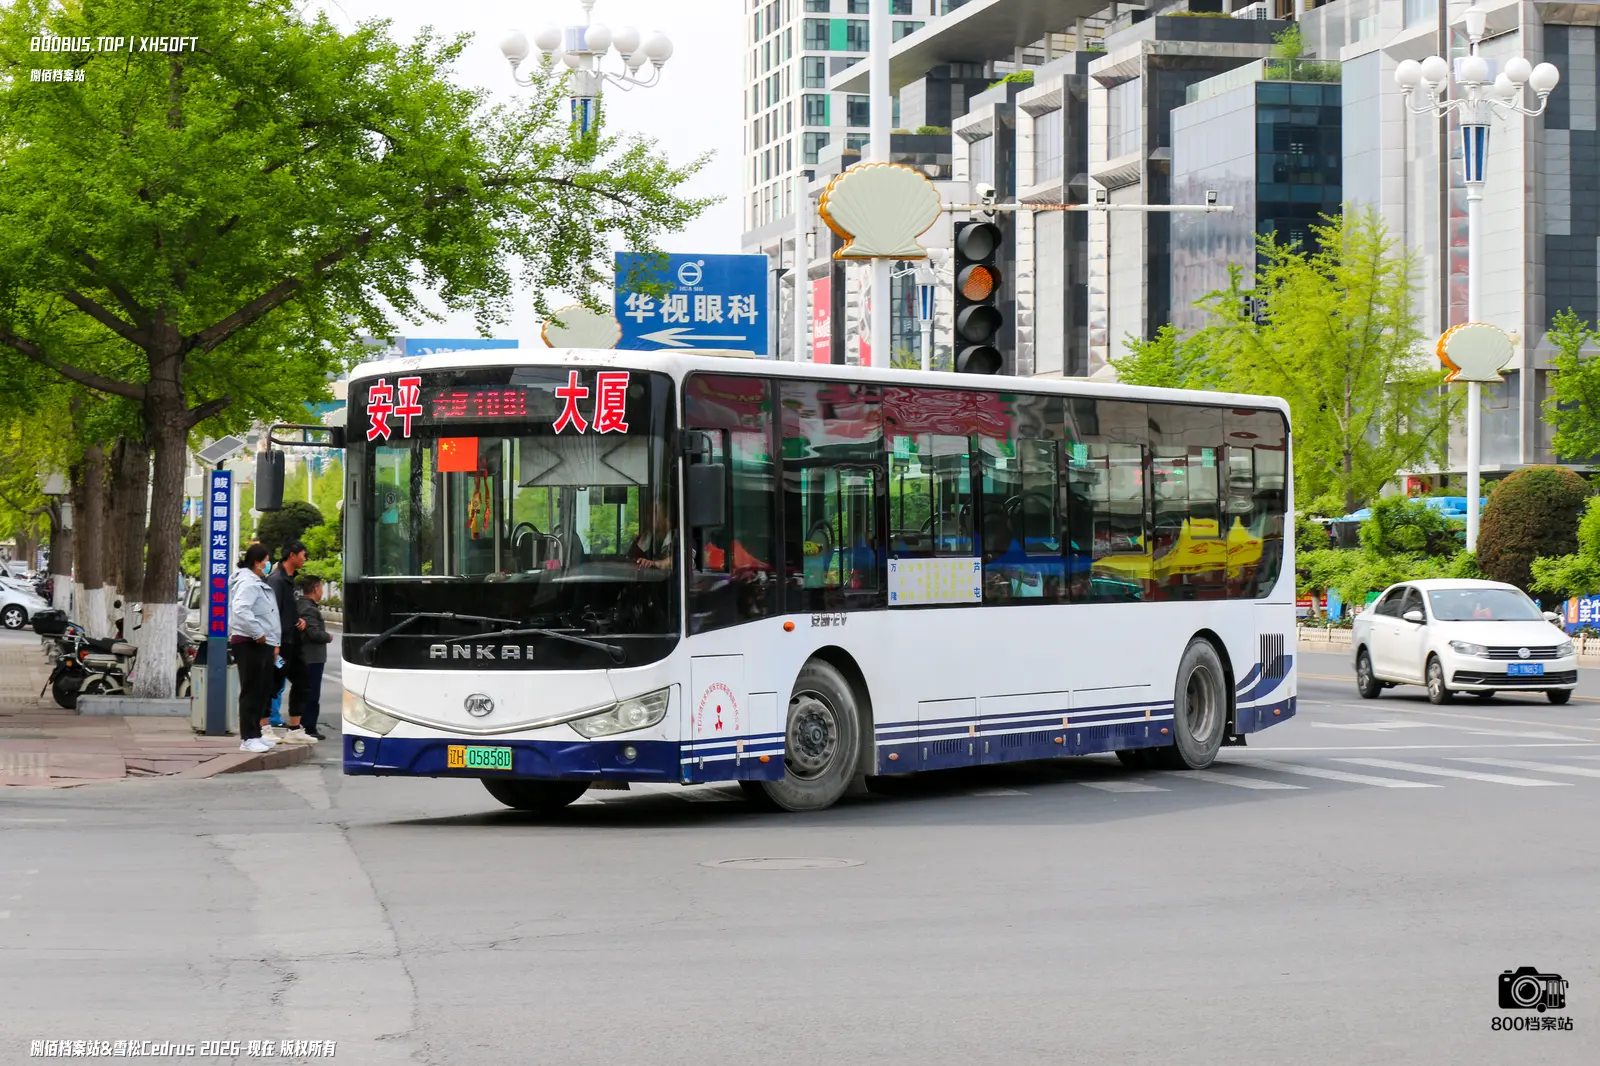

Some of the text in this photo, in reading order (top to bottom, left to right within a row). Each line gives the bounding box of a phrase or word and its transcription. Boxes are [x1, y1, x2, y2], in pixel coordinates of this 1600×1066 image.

[624, 292, 759, 325] 华视眼科
[367, 370, 629, 441] 安平 大厦
[429, 644, 534, 660] ANKAI
[469, 749, 511, 767] 05858D
